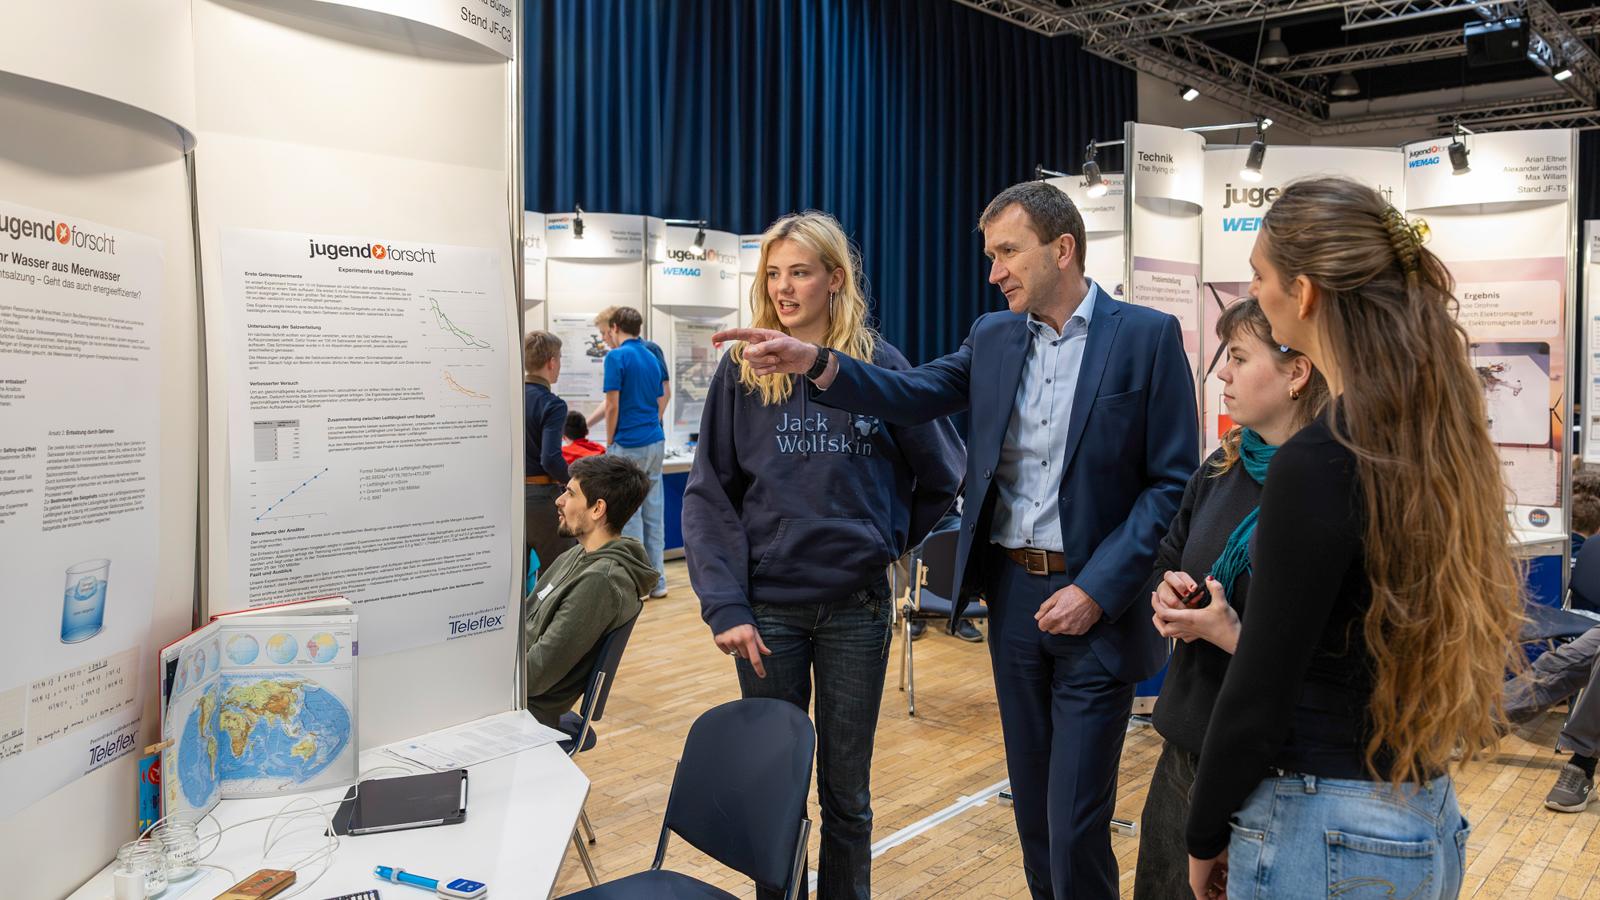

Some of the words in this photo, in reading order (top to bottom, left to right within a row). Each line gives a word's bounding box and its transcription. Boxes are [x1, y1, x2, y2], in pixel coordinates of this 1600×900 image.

[461, 7, 487, 29] Stand
[490, 21, 511, 42] JF-C3
[1137, 151, 1174, 163] Technik
[1409, 156, 1440, 168] WEMAG
[1223, 184, 1280, 208] juge
[0, 214, 55, 242] ugend
[71, 225, 115, 255] forscht
[309, 240, 372, 260] jugend
[387, 245, 436, 263] forscht
[668, 249, 706, 262] ugend
[12, 252, 50, 270] Wasser
[52, 262, 68, 273] aus
[72, 262, 120, 282] Meerwasser
[663, 267, 702, 276] WEMAG
[0, 270, 35, 285] tsalzung
[44, 275, 60, 288] Geht
[62, 279, 74, 289] das
[76, 282, 92, 292] auch
[1464, 292, 1500, 300] Ergebnis
[776, 412, 828, 432] Jack
[776, 434, 872, 456] Wolfskin
[449, 616, 501, 634] Teleflex
[90, 732, 136, 766] Teleflex
